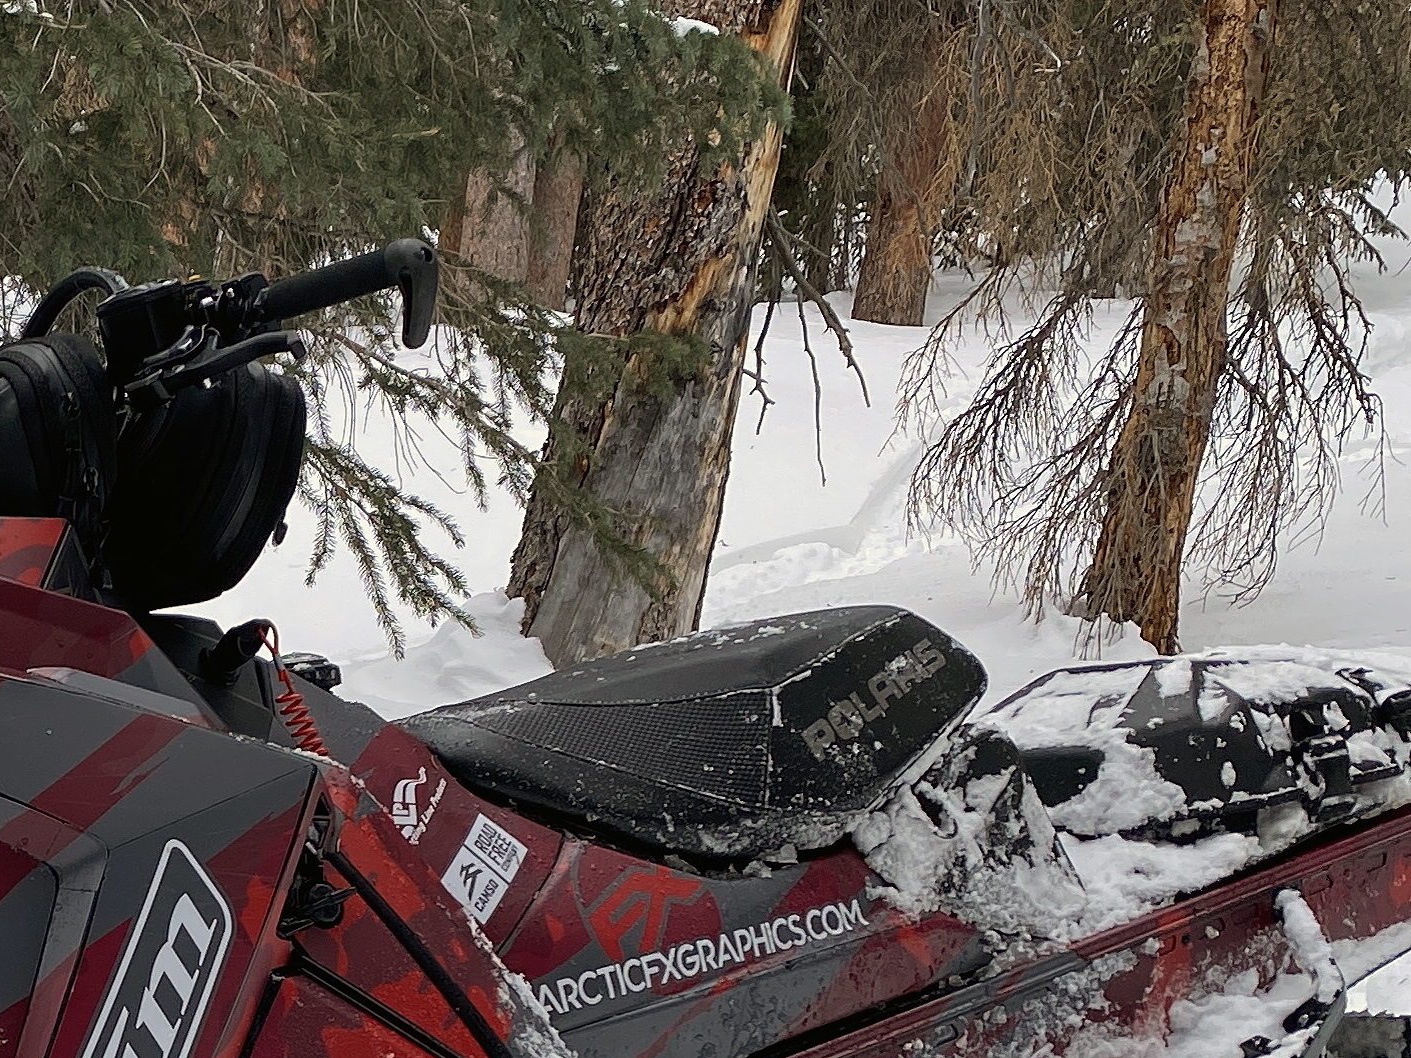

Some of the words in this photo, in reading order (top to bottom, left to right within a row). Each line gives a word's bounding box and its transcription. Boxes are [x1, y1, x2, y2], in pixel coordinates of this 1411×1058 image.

[801, 638, 947, 763] POLARIS
[474, 822, 497, 855] ROAD
[488, 833, 512, 866] FREE
[474, 878, 499, 913] CAMSO
[539, 899, 870, 1014] ARCTICFXGRAPHICS.COM
